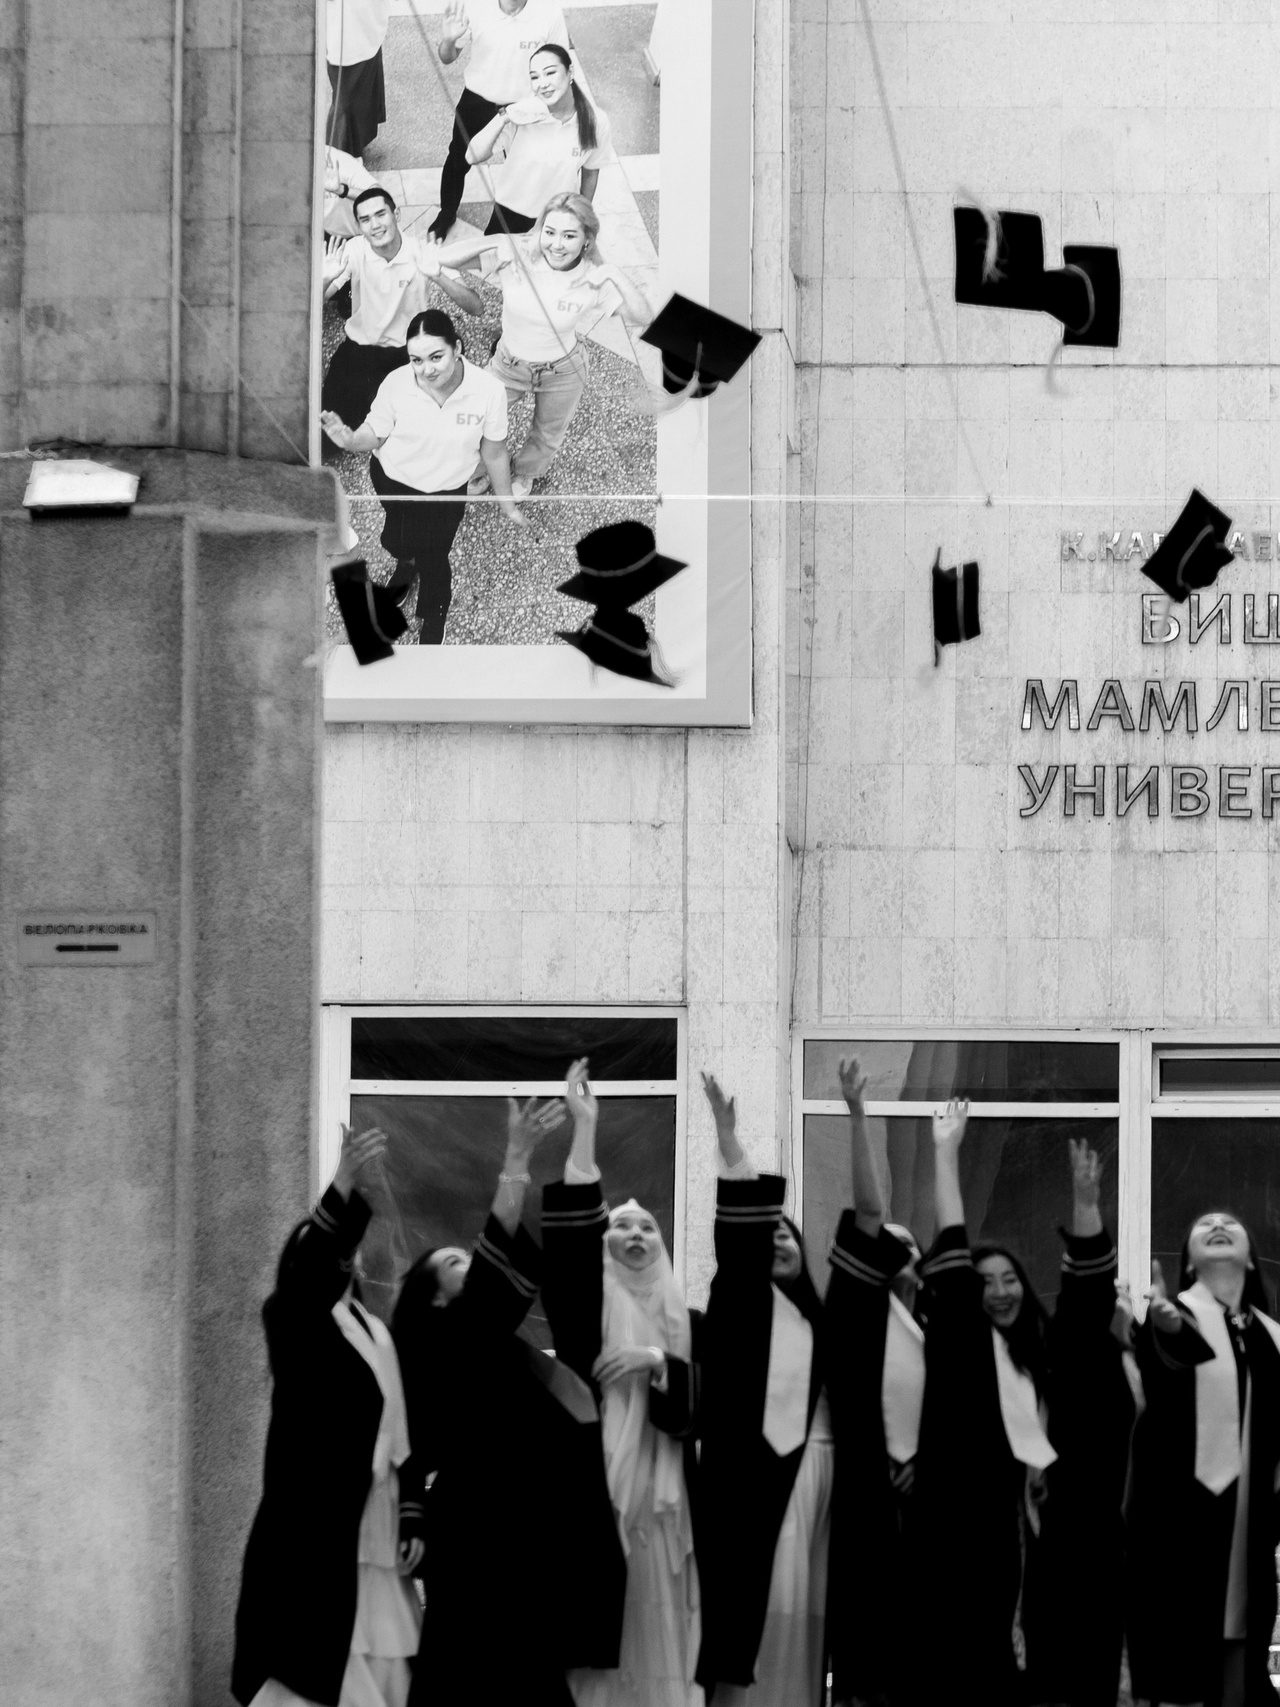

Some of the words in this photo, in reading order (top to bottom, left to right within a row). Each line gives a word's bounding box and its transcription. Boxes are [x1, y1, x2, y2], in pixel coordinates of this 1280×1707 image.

[557, 300, 584, 313] БГУ
[456, 412, 485, 426] БГУ
[25, 924, 148, 935] ВЕЛОПАРКОВКА
